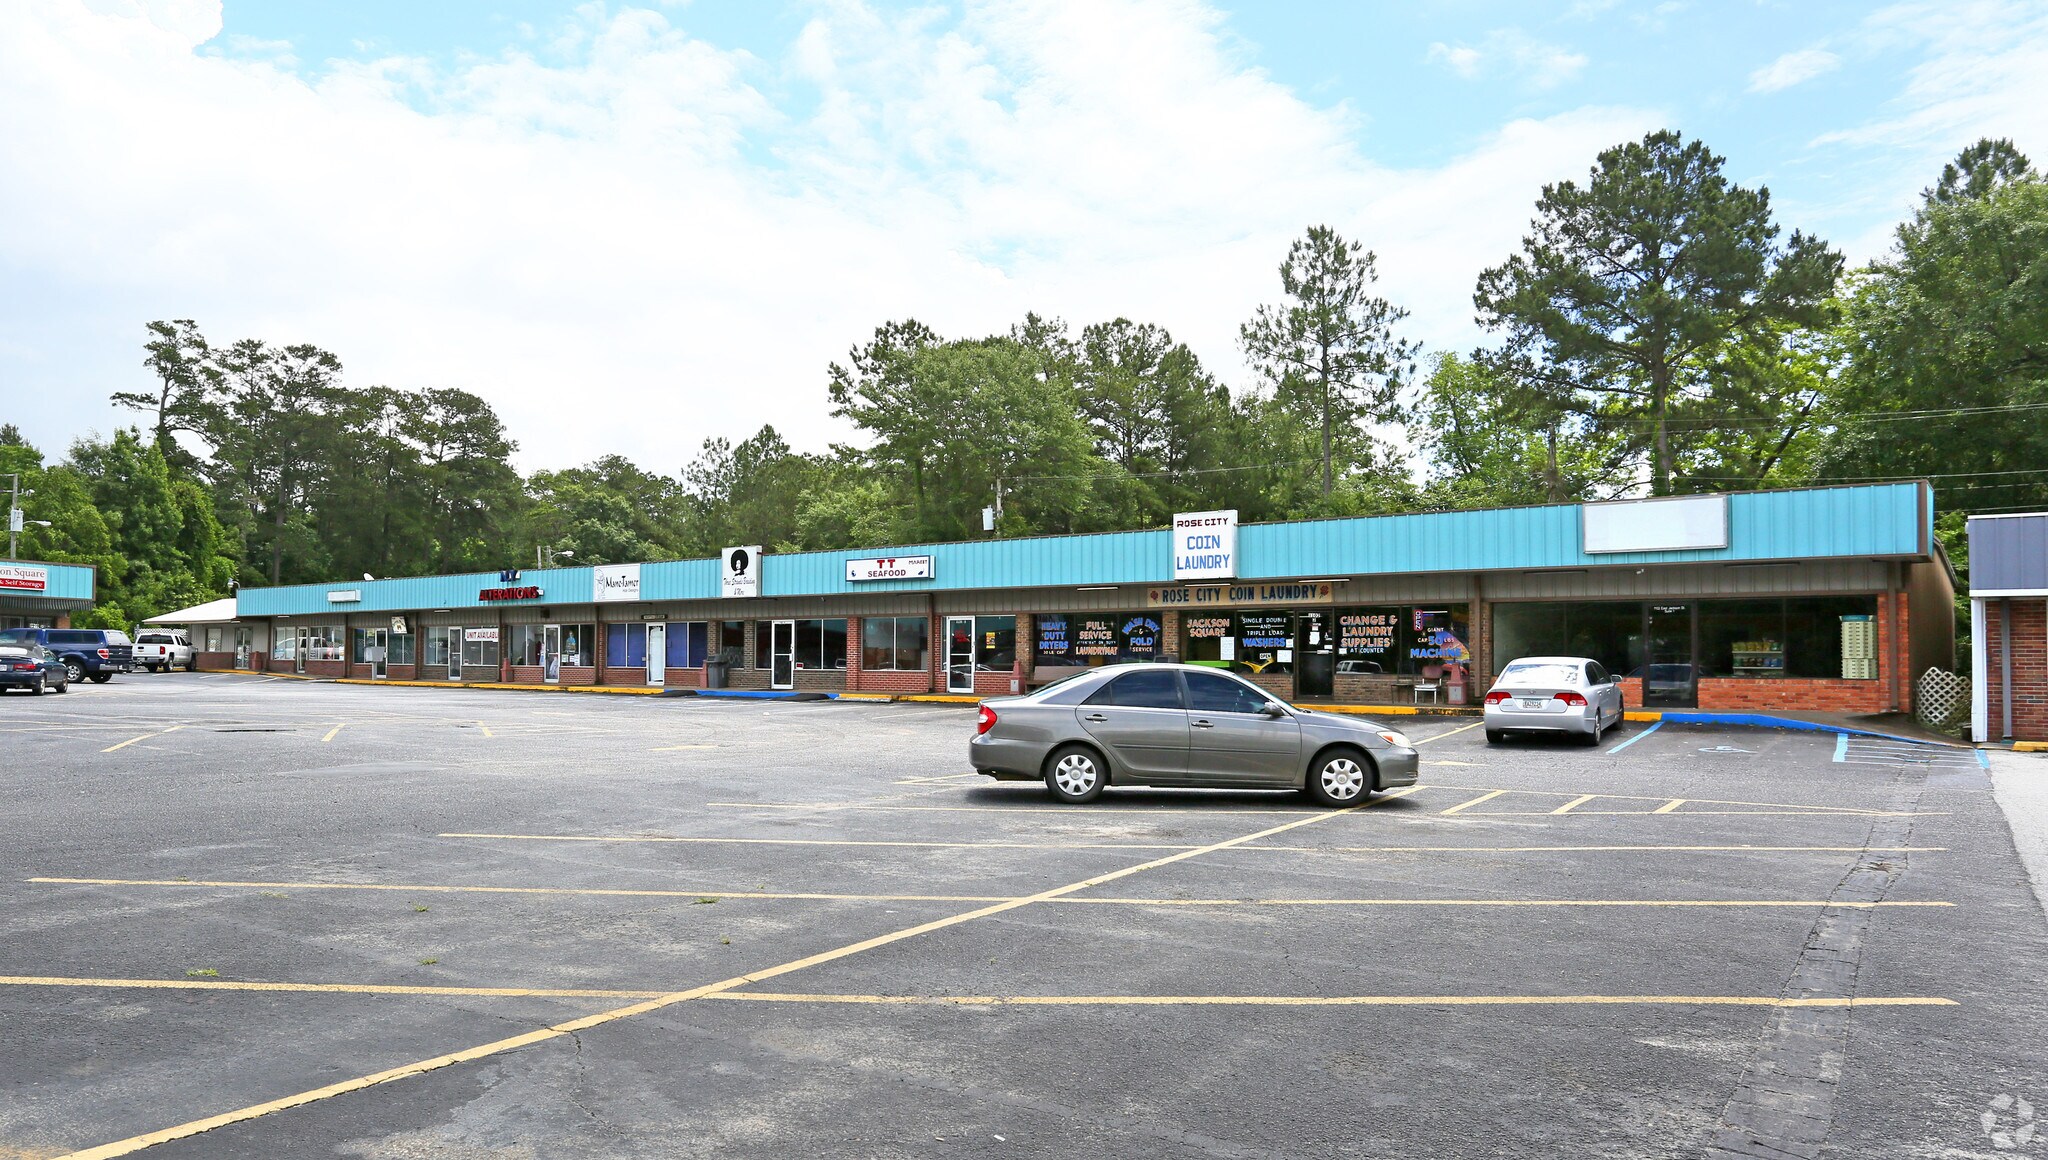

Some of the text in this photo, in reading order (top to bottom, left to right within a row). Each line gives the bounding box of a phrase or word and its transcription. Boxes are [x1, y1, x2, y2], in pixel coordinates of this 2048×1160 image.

[1177, 517, 1229, 528] ROSE CITY
[1187, 535, 1220, 550] COIN
[1176, 554, 1230, 570] LAUNDRY
[14, 568, 45, 579] Square
[867, 570, 906, 578] SEAFOOD
[5, 579, 18, 587] Self
[18, 580, 43, 588] Storage
[479, 586, 539, 601] ALTERATIONS
[1162, 584, 1317, 603] ROSE CITY COIN LAUNDRY
[1186, 618, 1230, 629] JACKSON
[1340, 614, 1398, 626] CHANGE &
[1086, 621, 1107, 631] FULL
[1122, 617, 1161, 635] WASH DRY
[1342, 626, 1394, 637] LAUNDRY
[477, 631, 498, 639] AVAILABL
[1044, 631, 1066, 641] DUTY
[1079, 630, 1112, 640] SERVICE
[1190, 627, 1226, 638] SQUARE
[1039, 640, 1069, 650] DRYERS
[1130, 636, 1154, 646] FOLD
[1242, 637, 1286, 648] WASHERS
[1340, 637, 1391, 648] SUPPLIES
[1428, 635, 1444, 646] 50
[1410, 648, 1462, 659] MACHINE
